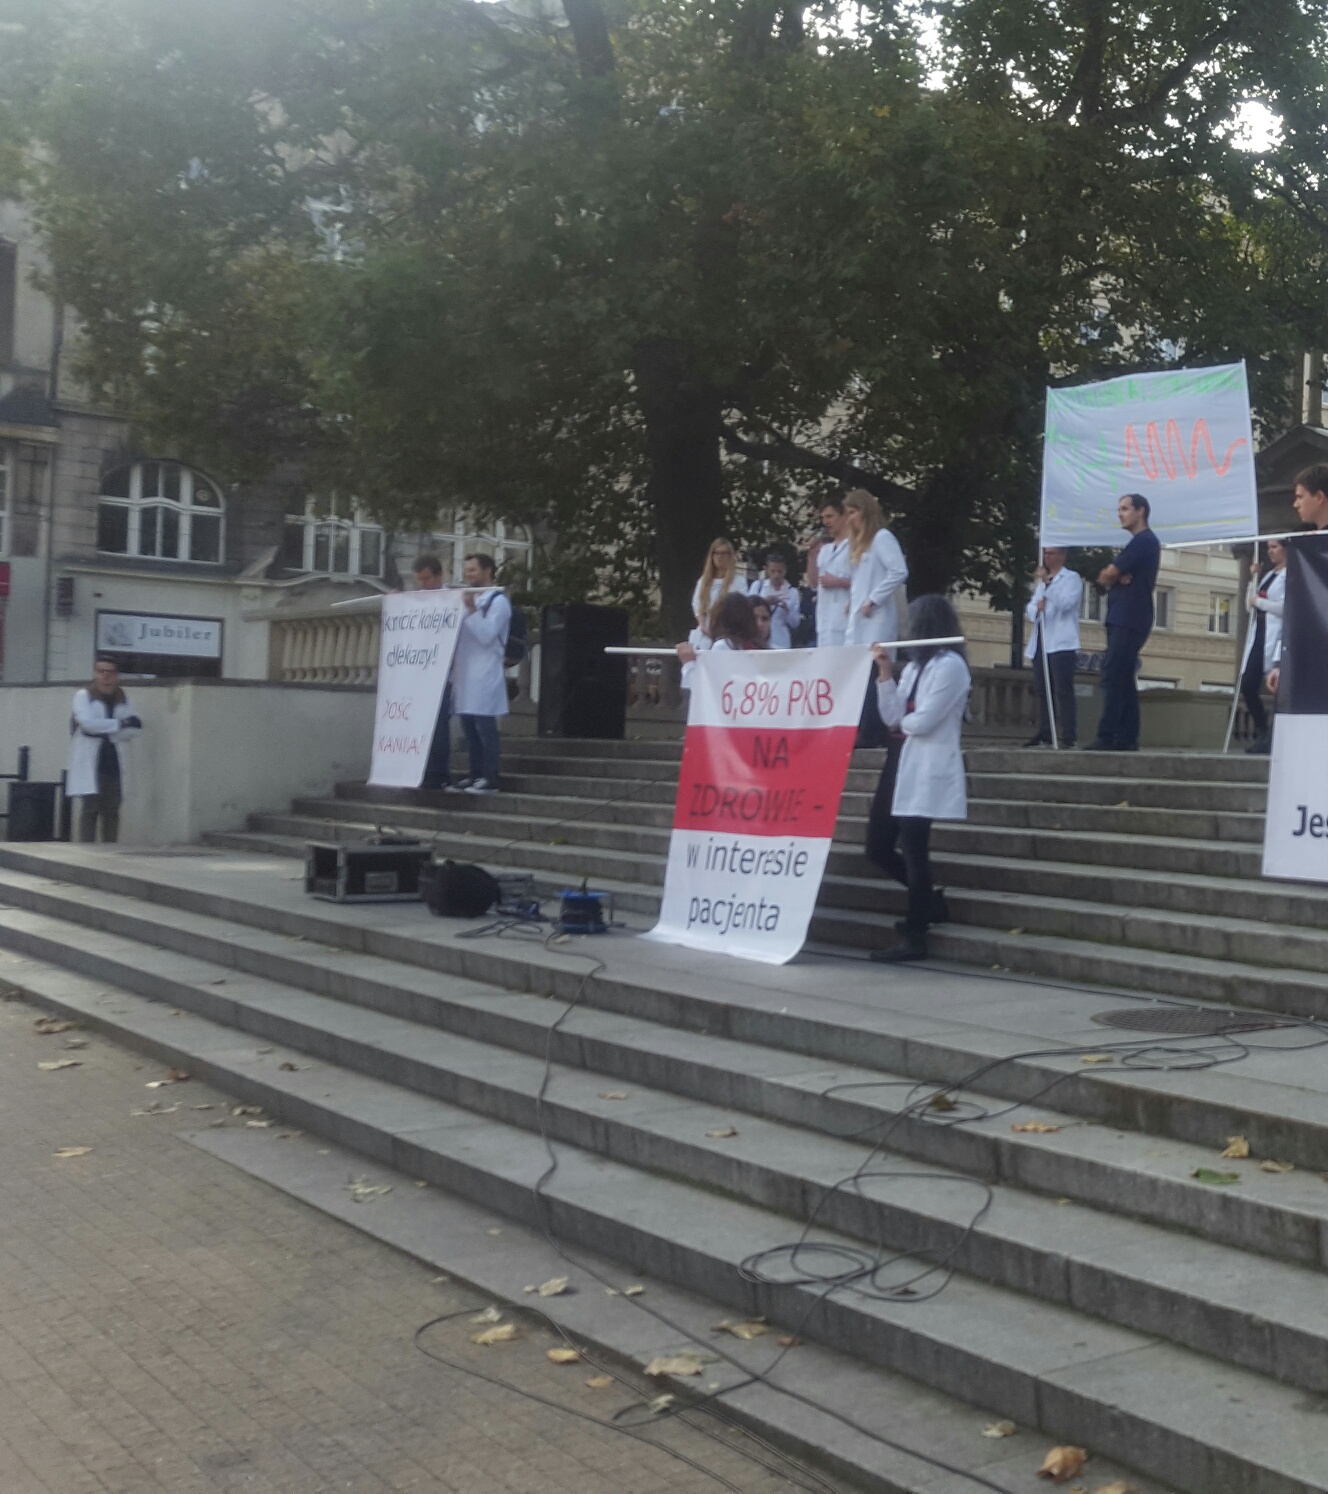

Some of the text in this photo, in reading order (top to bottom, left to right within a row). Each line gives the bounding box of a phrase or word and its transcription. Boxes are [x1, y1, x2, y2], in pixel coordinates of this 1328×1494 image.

[137, 622, 212, 640] Jubiler
[720, 678, 834, 720] 6,8% PKB
[752, 736, 789, 768] NA
[689, 783, 806, 822] ZDROWIE
[704, 837, 809, 877] interesie
[686, 893, 781, 935] pacjenta
